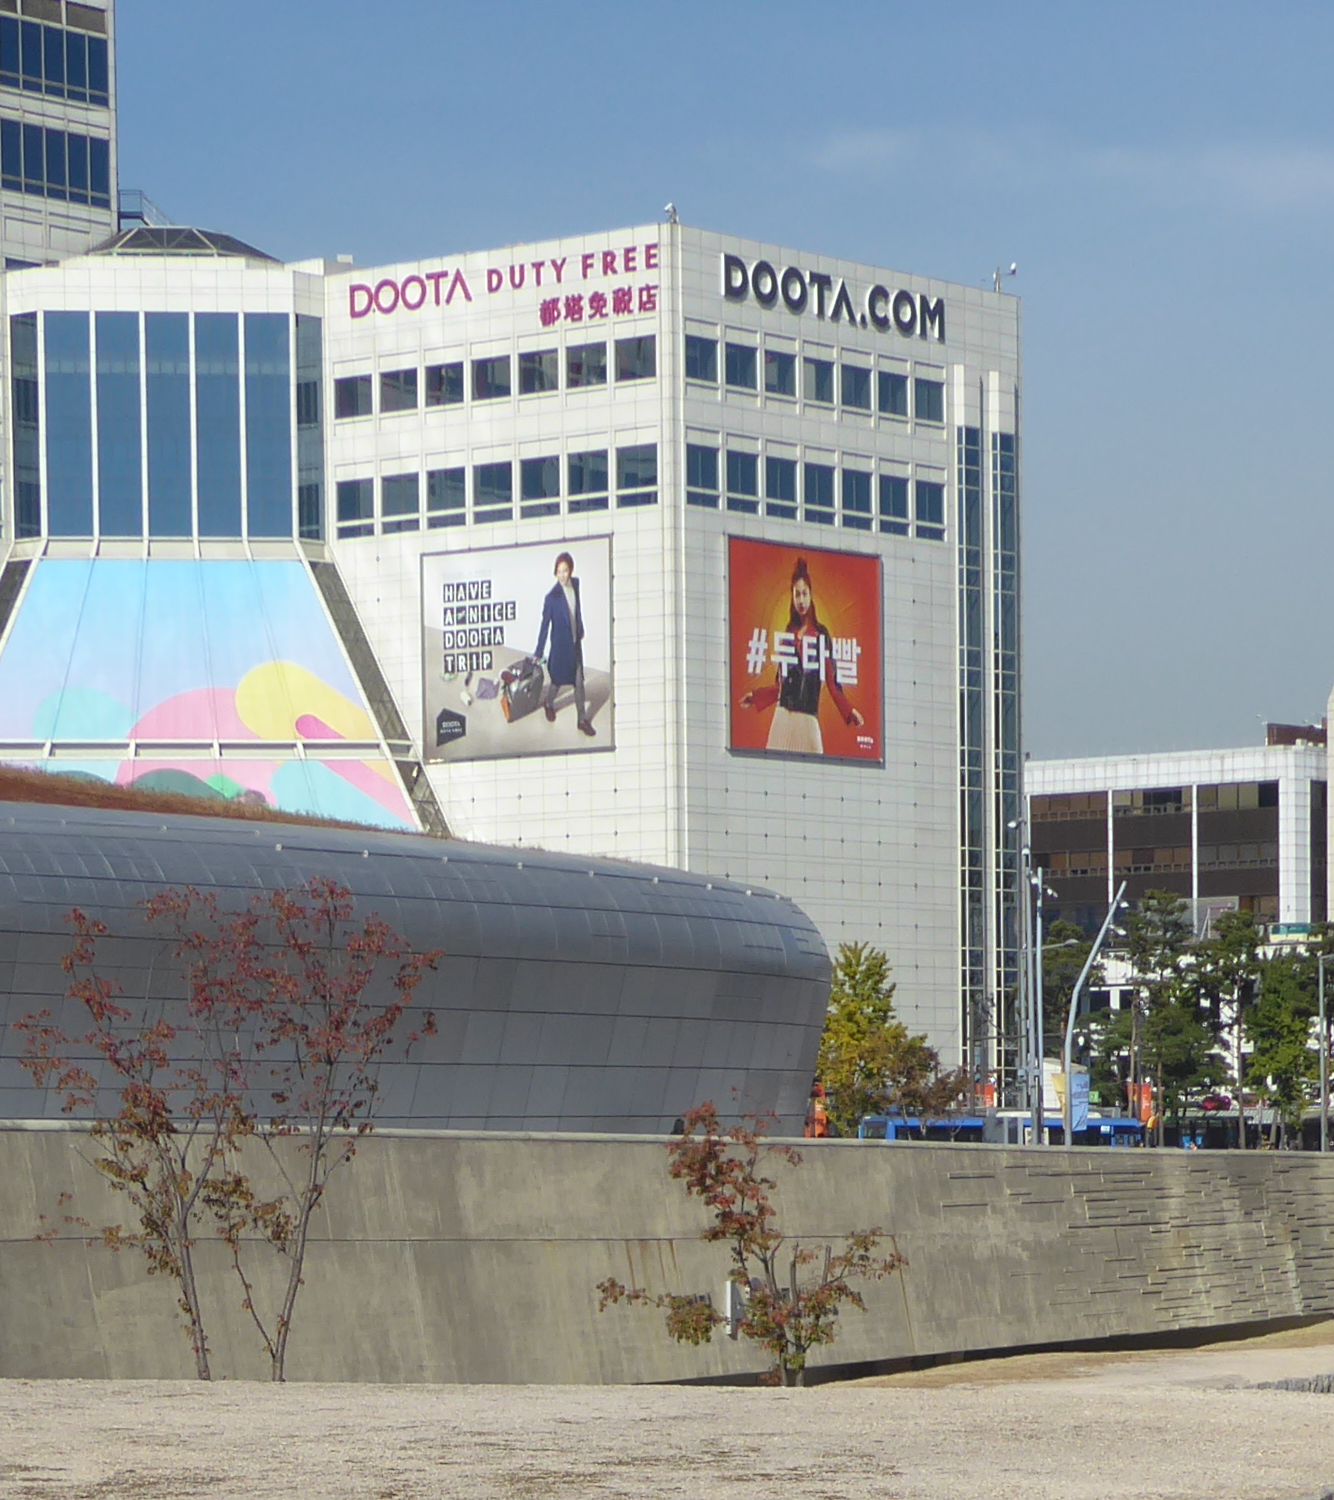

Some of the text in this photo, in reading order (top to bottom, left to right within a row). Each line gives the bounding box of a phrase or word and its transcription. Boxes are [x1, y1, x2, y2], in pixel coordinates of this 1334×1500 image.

[349, 243, 659, 319] DOOTA DUTY FREE
[722, 253, 946, 343] DOOTA.COM
[444, 582, 490, 602] HAVE
[444, 602, 515, 626] A NICE
[444, 627, 503, 648] DOOTA
[445, 652, 491, 673] TRIP
[746, 627, 862, 685] #두타빨
